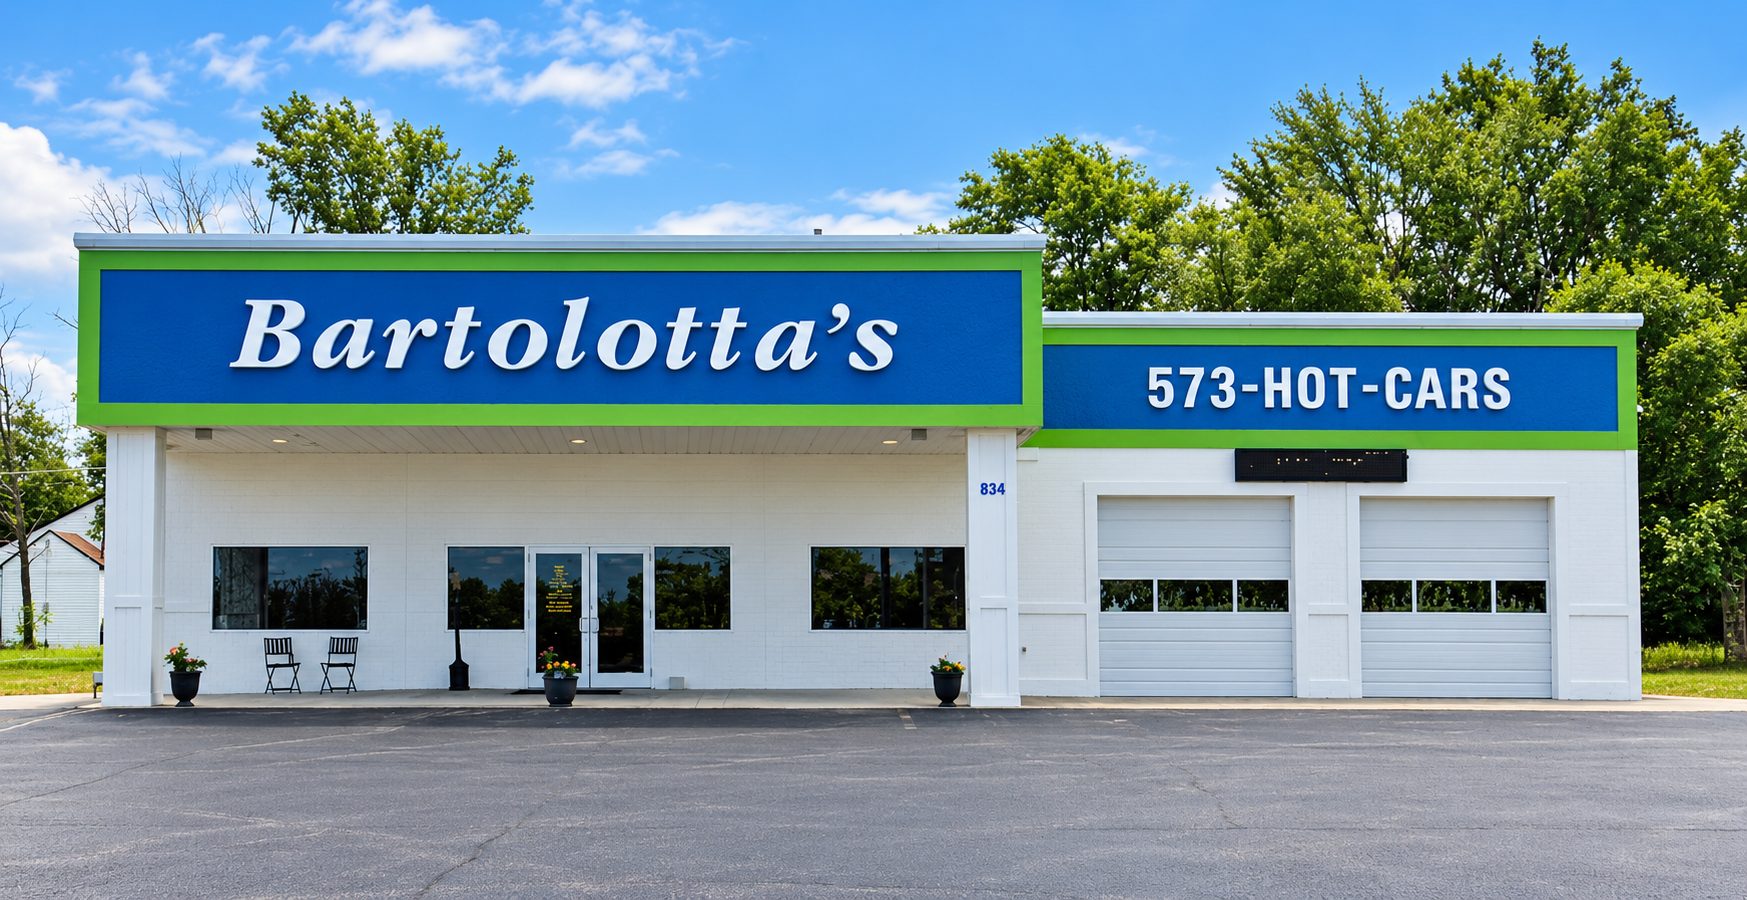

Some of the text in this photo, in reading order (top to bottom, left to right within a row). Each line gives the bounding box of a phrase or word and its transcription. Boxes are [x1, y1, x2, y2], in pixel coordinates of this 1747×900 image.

[229, 296, 899, 371] Bartolotta's
[1147, 366, 1512, 410] 573-HOT-CARS
[980, 482, 1006, 496] 834
